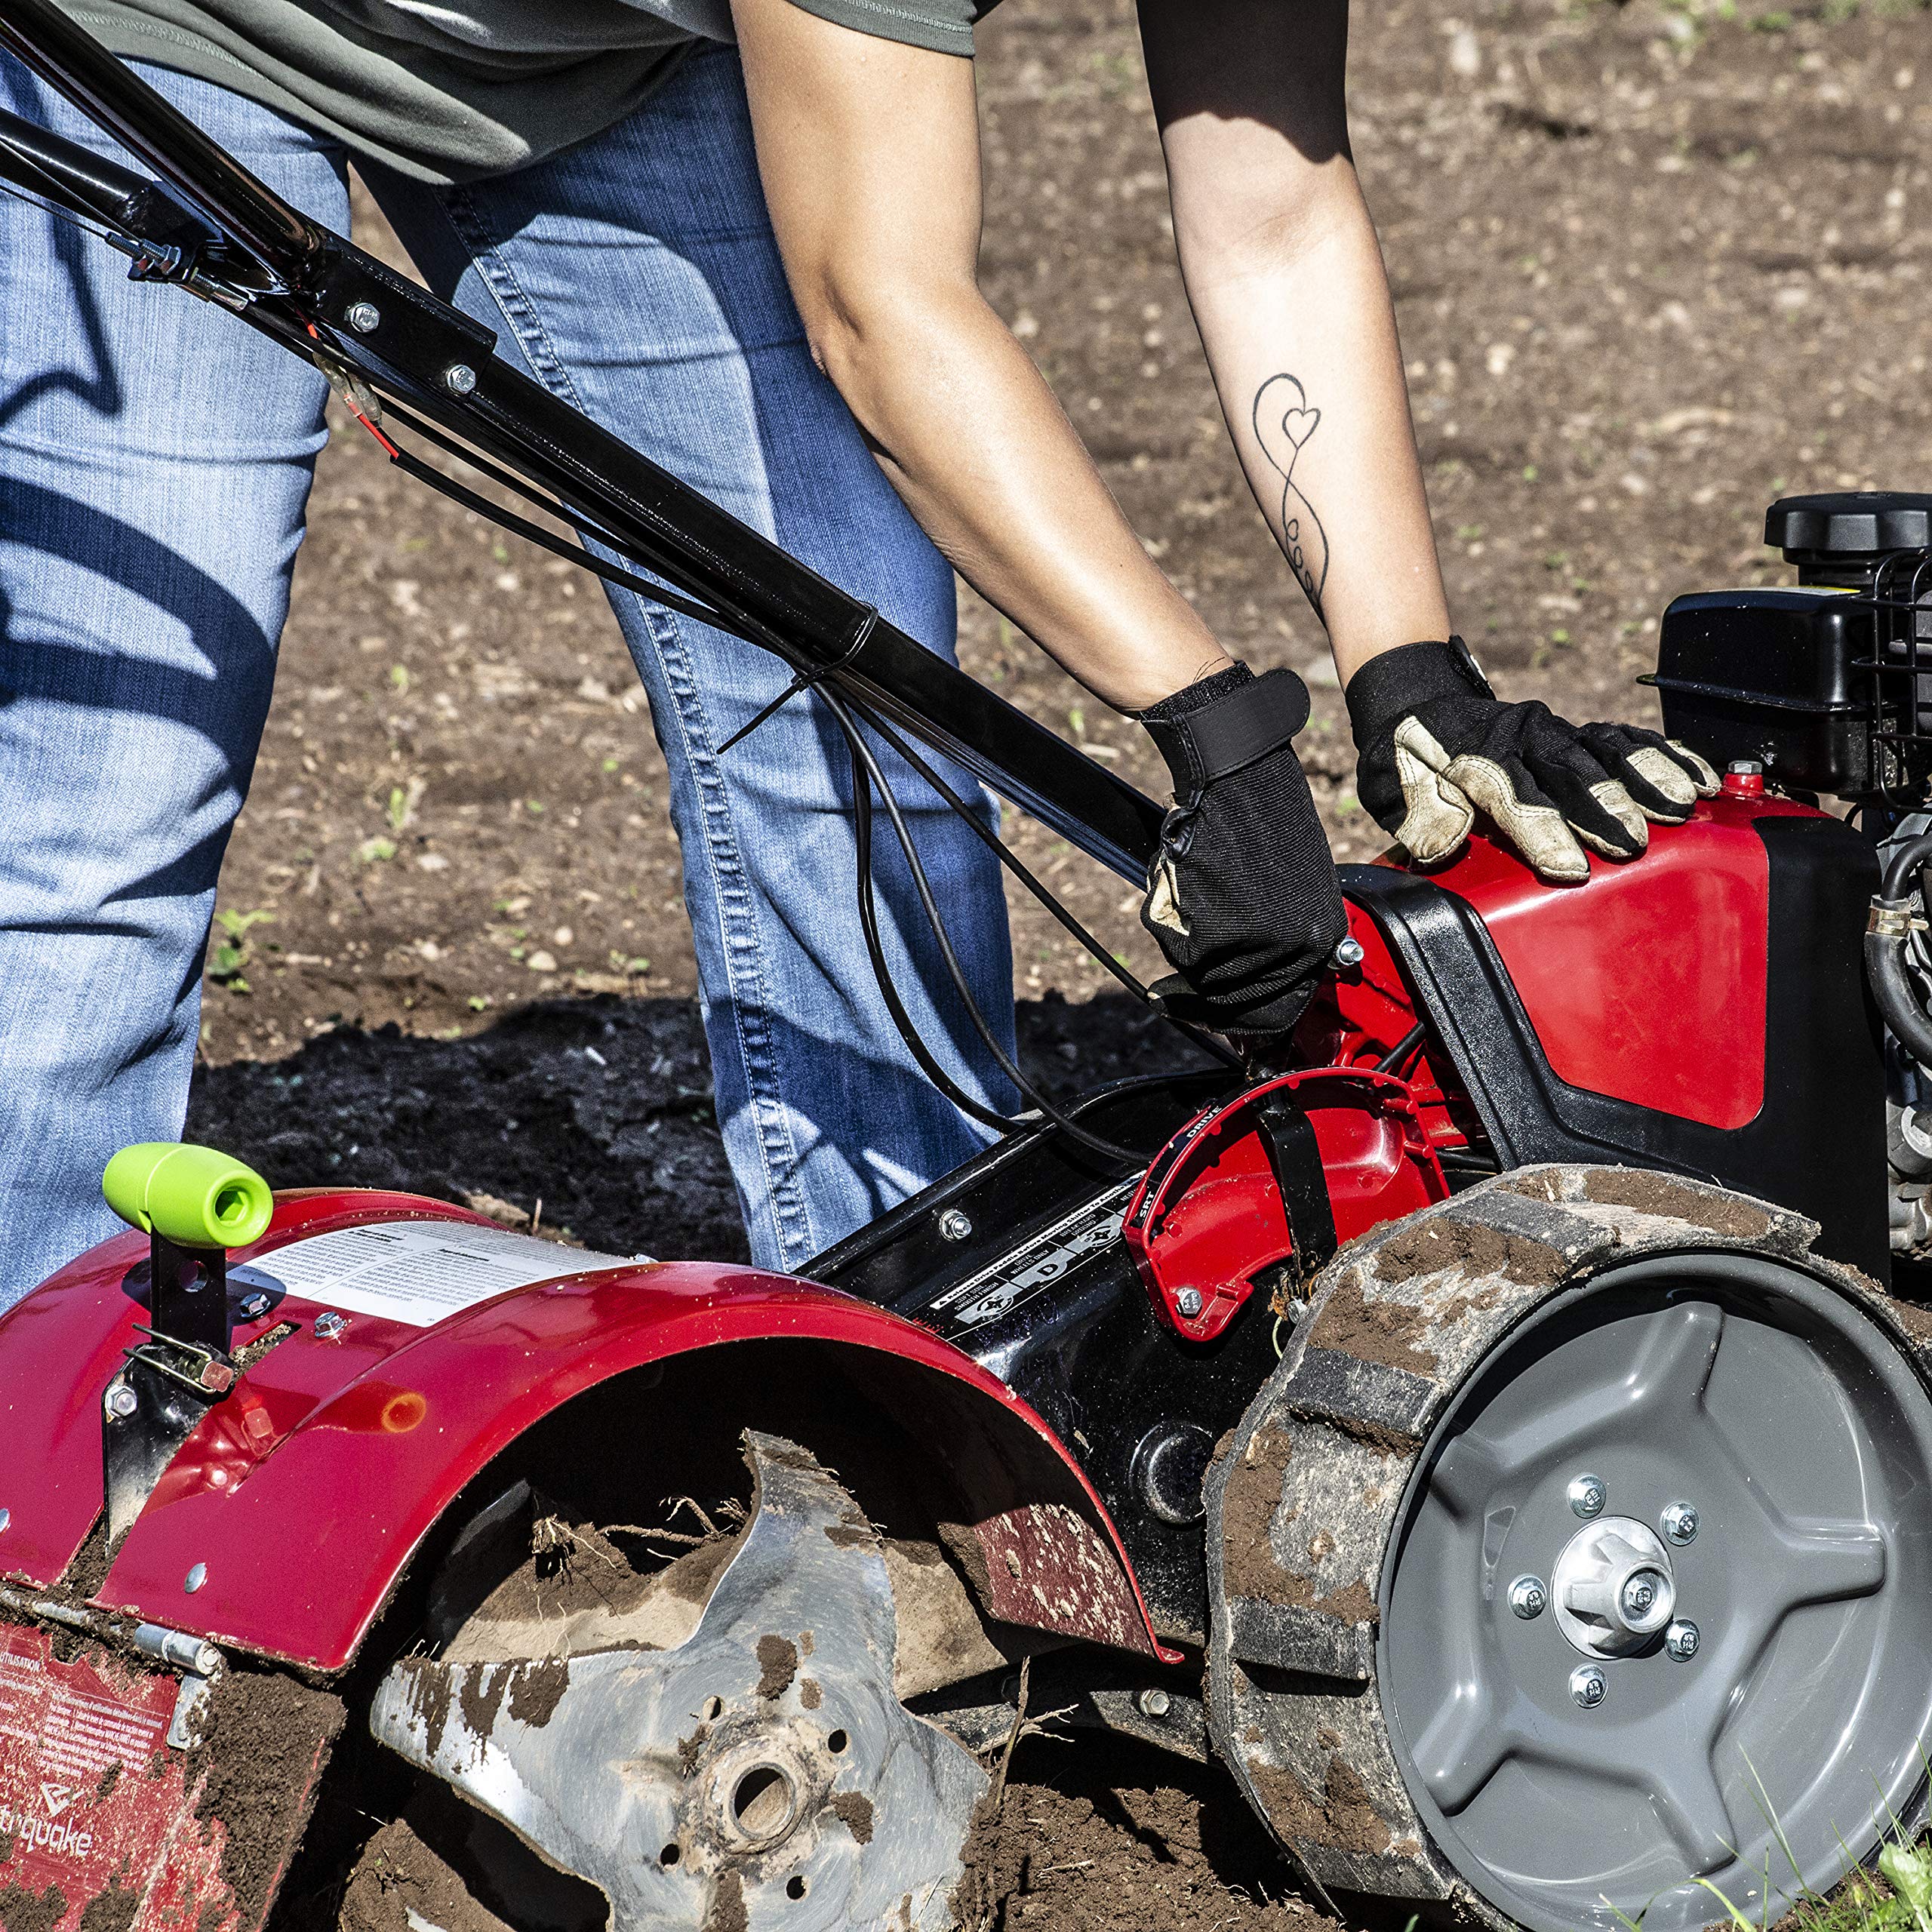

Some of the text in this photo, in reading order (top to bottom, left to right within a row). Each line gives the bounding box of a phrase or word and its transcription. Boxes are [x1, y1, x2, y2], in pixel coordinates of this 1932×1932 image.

[1186, 1106, 1223, 1138] DRIVE
[1140, 1191, 1155, 1218] SRT
[1079, 1214, 1096, 1226] HARD
[947, 1281, 974, 1300] Release
[974, 1269, 994, 1282] Drive
[994, 1254, 1018, 1270] Paddle
[1017, 1240, 1041, 1254] Before
[1041, 1223, 1068, 1239] Moving
[1067, 1208, 1091, 1223] Shifter
[1010, 1249, 1049, 1275] WHEELS ONLY
[1037, 1263, 1058, 1276] D
[955, 1291, 971, 1304] SOFT
